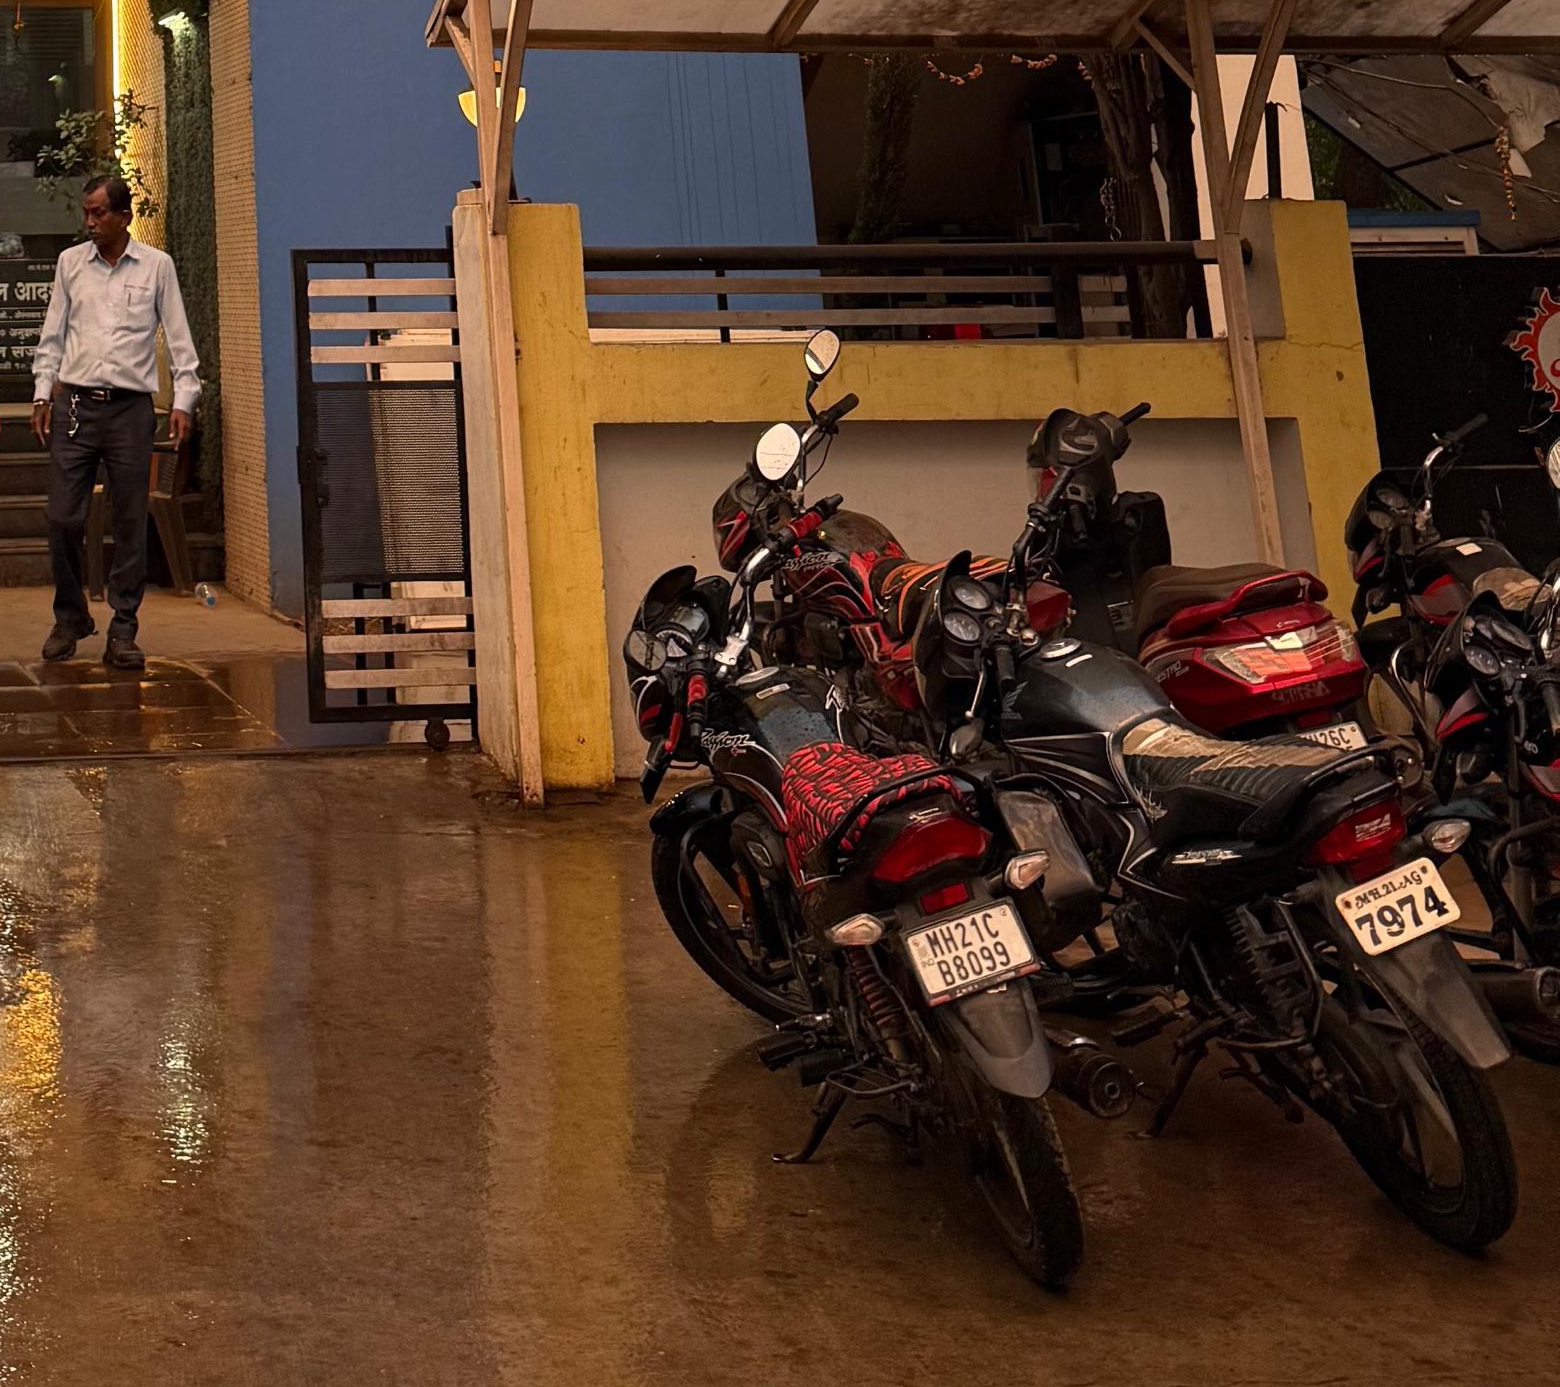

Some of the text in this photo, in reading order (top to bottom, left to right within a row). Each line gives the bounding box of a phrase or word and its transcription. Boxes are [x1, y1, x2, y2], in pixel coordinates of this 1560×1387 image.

[925, 913, 999, 958] MH21C
[1355, 885, 1449, 947] 7974
[937, 942, 1011, 986] B8099
